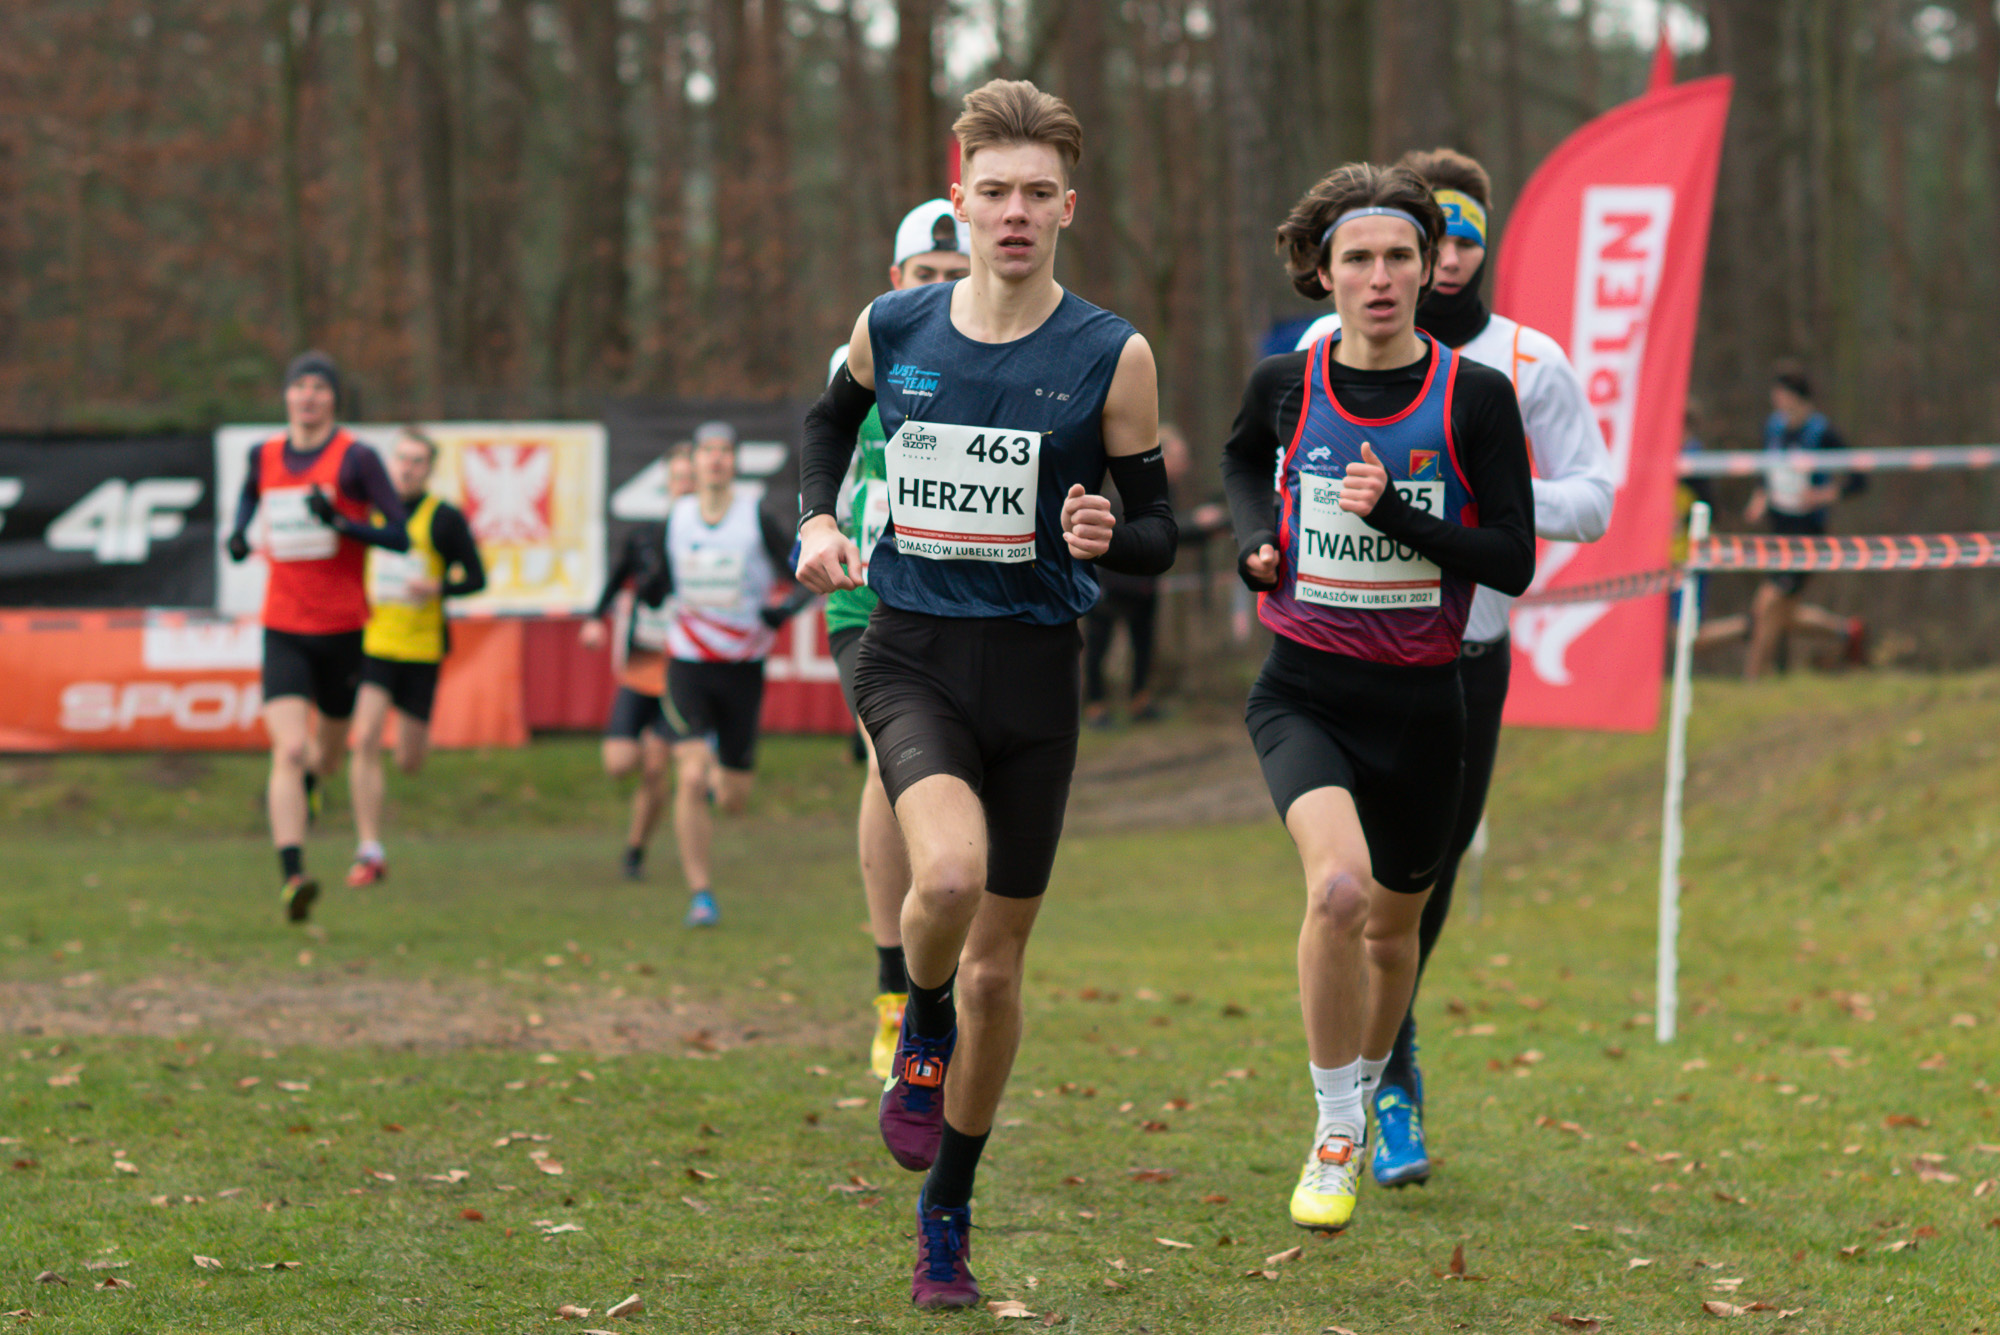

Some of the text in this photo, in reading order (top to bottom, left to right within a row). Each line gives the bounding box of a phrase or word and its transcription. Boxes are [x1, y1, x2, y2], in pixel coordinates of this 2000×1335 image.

[889, 363, 918, 377] JUST
[904, 377, 939, 391] TEAM
[966, 434, 1031, 466] 463
[898, 476, 1026, 515] HERZYK
[44, 476, 205, 566] 4F
[955, 546, 1004, 558] LUBELSKI
[1007, 546, 1032, 558] 2021
[1304, 527, 1424, 563] TWARDO
[1302, 586, 1433, 605] TOMASZÓW LUBELSKI 2021
